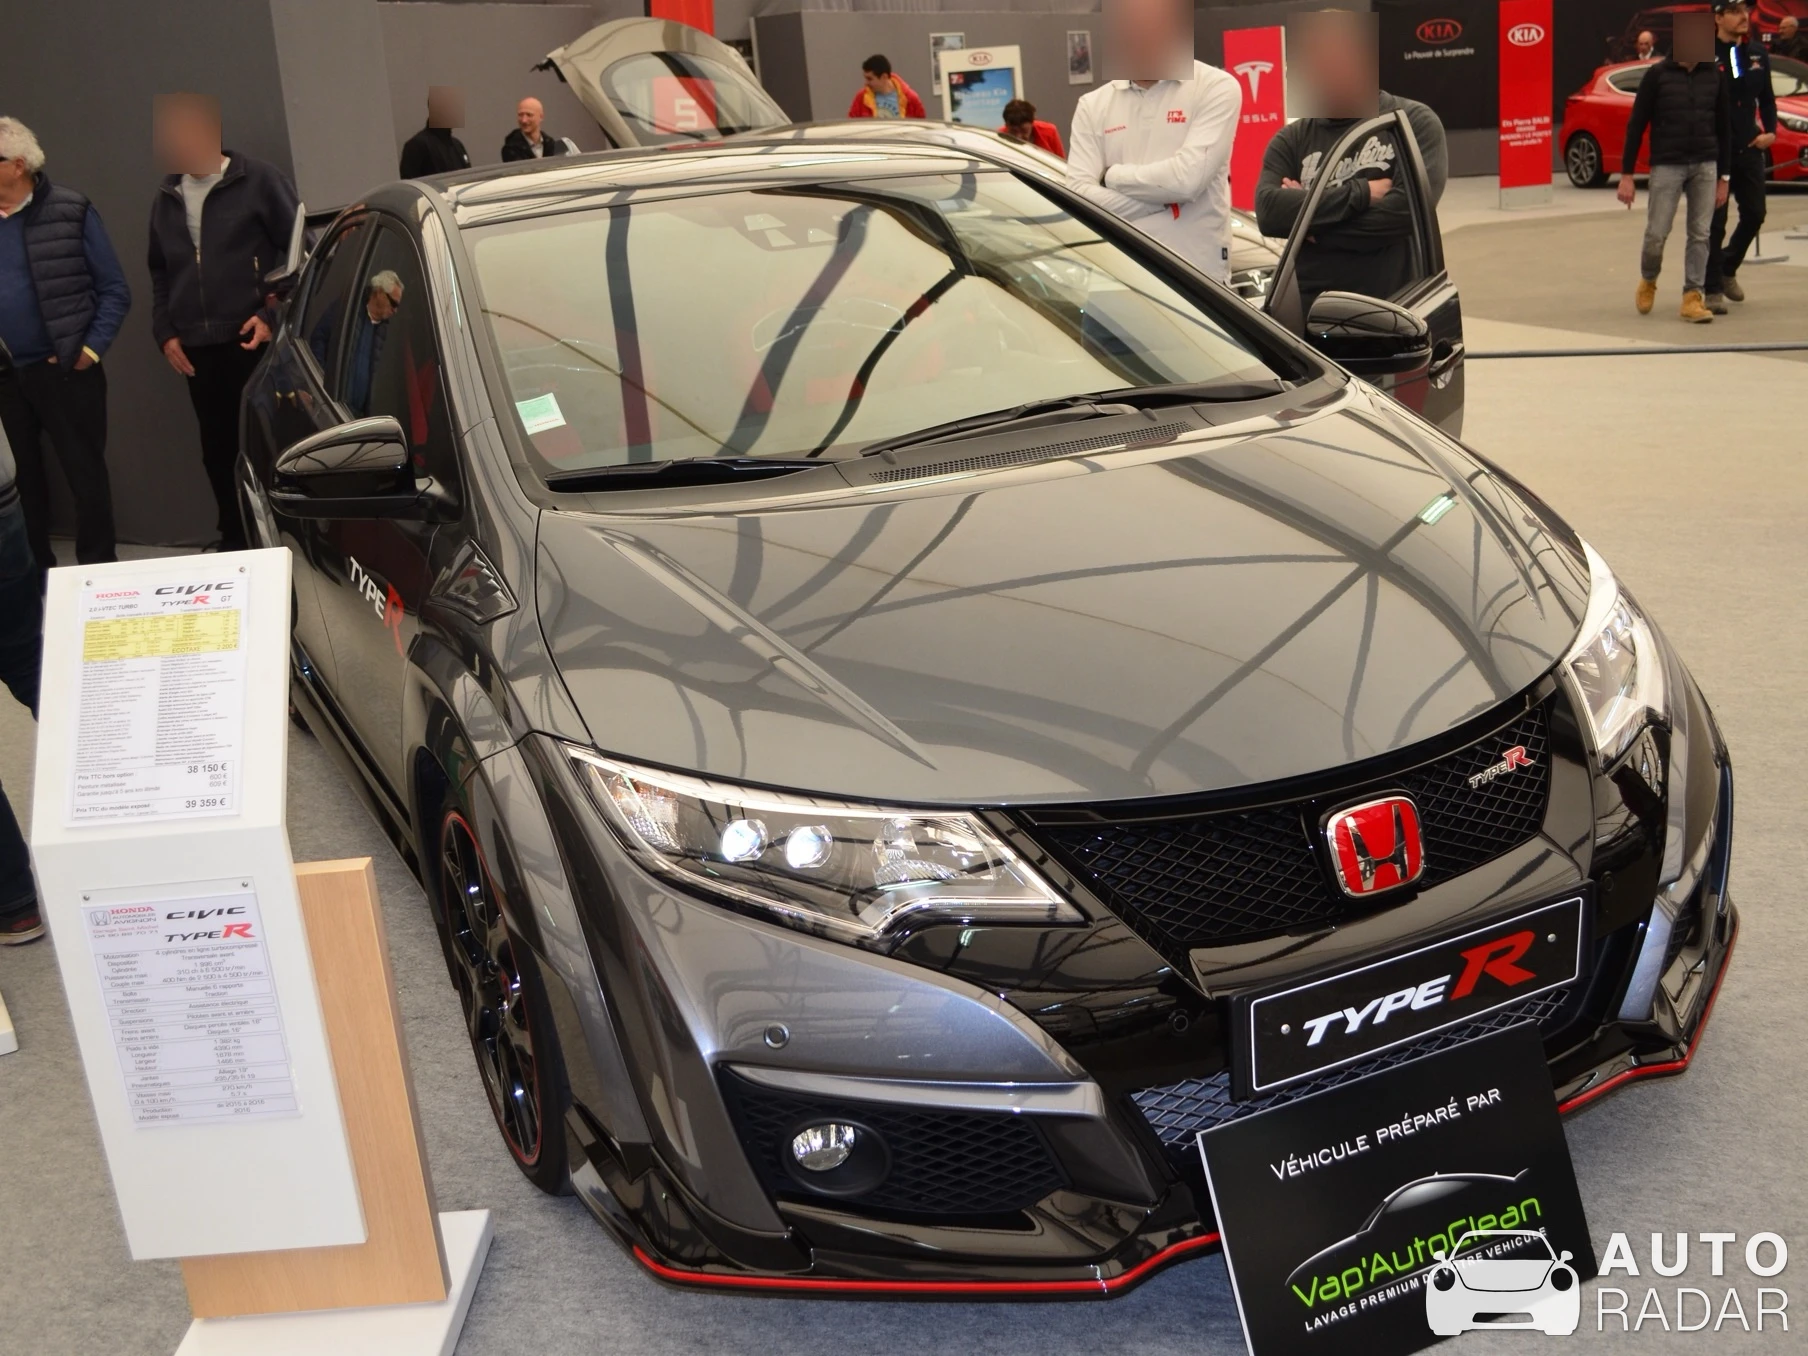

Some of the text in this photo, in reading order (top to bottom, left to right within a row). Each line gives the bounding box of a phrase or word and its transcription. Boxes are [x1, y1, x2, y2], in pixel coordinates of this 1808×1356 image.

[1425, 24, 1454, 38] KIA
[1514, 29, 1538, 42] KIA
[1243, 113, 1278, 124] ESLA
[1105, 125, 1127, 135] HONDA
[96, 591, 140, 599] HONDA
[155, 582, 235, 596] CIVIC
[221, 595, 232, 603] GT
[350, 556, 405, 658] TYPE R
[172, 646, 201, 654] ECOTAXE
[188, 763, 227, 774] 38 150 €
[1469, 746, 1535, 789] TYPE R
[186, 798, 226, 809] 39 359 €
[111, 906, 247, 920] HONDA CIVIC
[114, 917, 157, 925] AVIGNON
[165, 923, 256, 943] TYPE R
[211, 944, 258, 952] turbocompressé
[1303, 930, 1537, 1047] TYPE R
[1271, 1088, 1502, 1181] VÉHICULE PRÉPARÉ PAR
[1292, 1198, 1542, 1308] Vap'AutoClean
[1305, 1303, 1357, 1332] LAVAGE
[1361, 1278, 1420, 1310] PREMIUM
